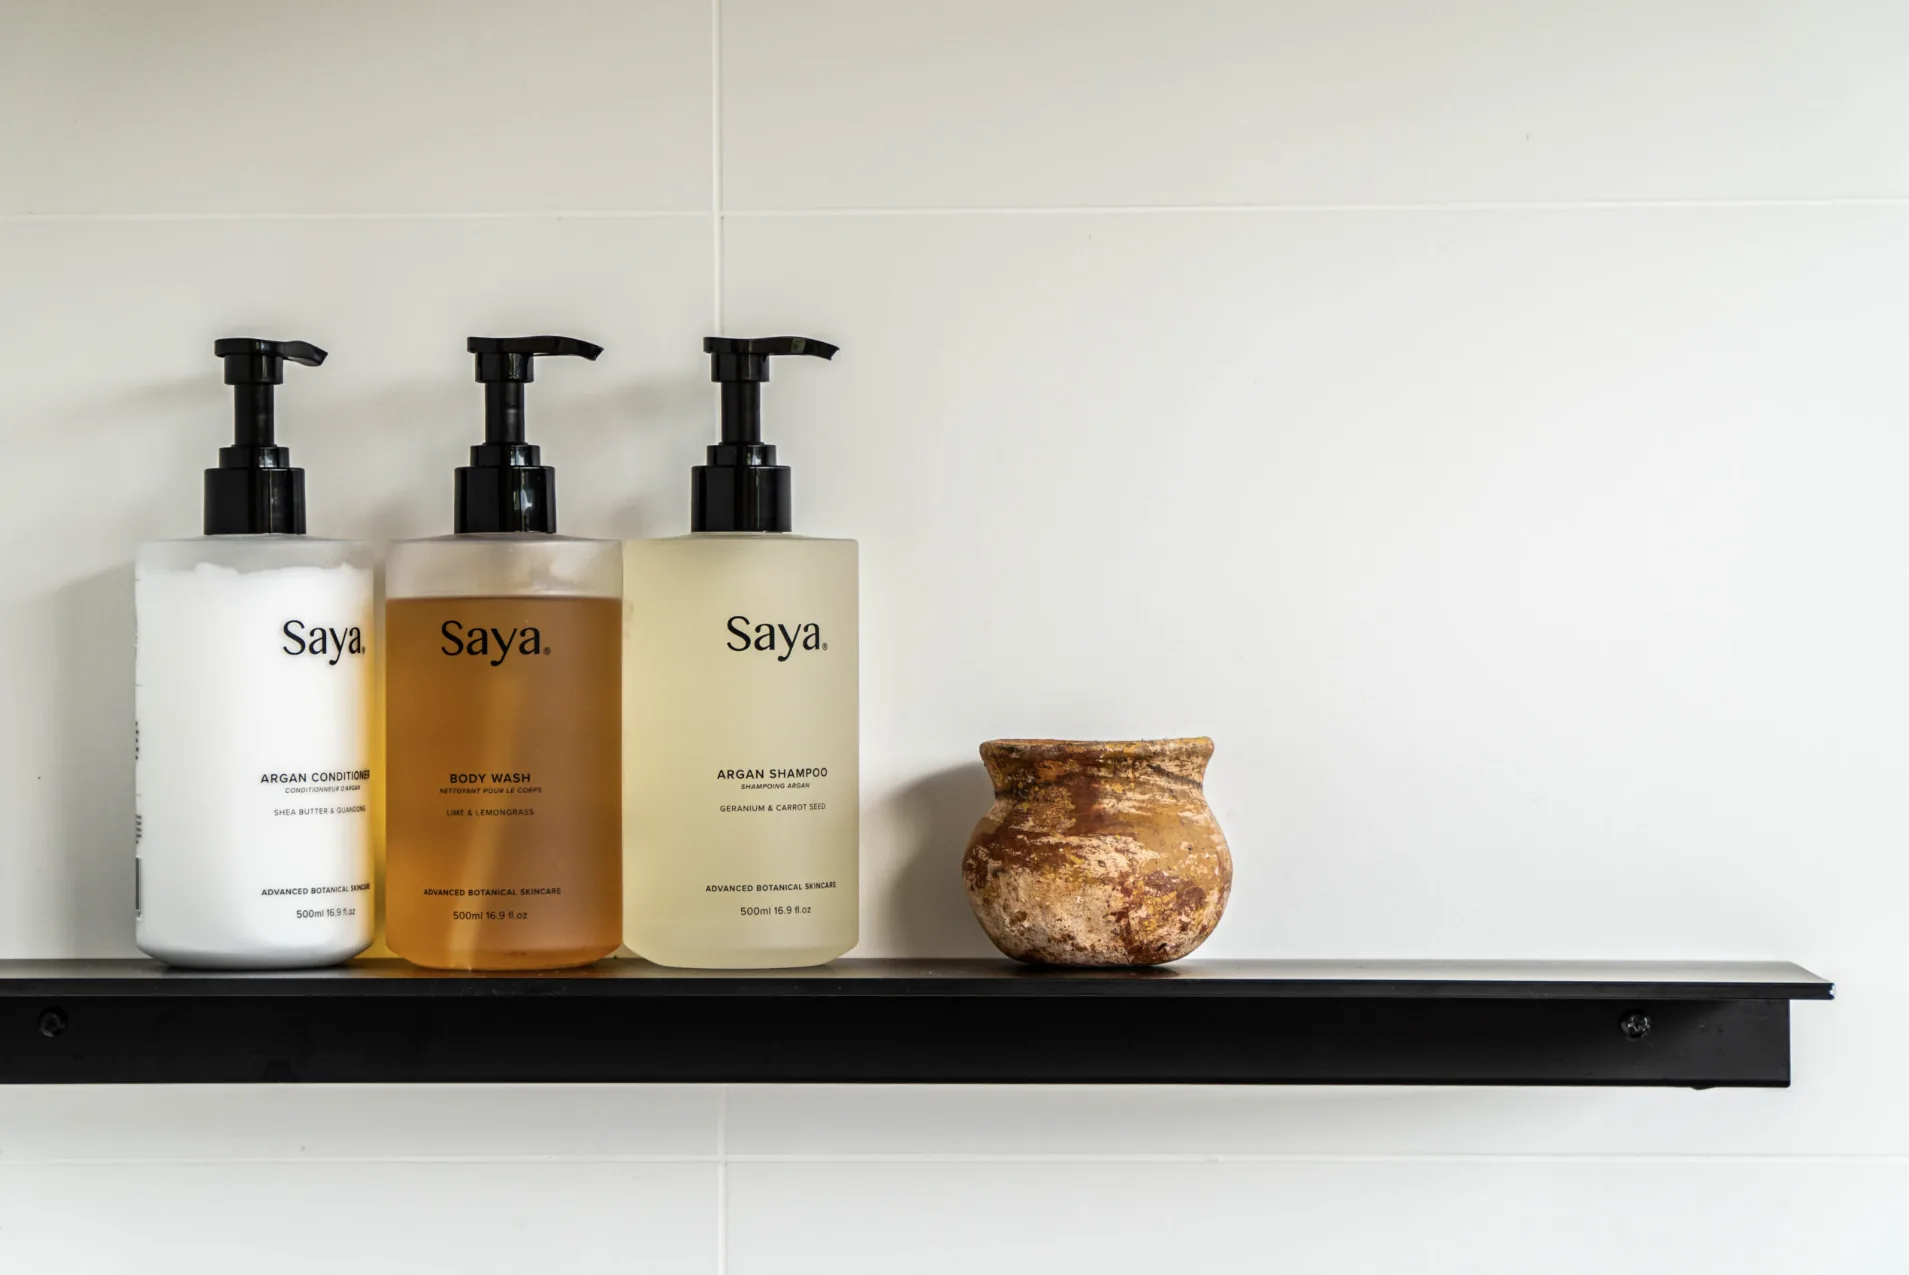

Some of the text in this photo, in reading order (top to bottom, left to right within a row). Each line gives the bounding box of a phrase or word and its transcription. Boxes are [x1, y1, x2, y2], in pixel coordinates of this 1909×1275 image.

[260, 769, 371, 784] ARGAN CONDITIONER
[450, 773, 531, 784] BODY WASH
[717, 767, 828, 780] ARGAN SHAMPOO
[299, 807, 328, 816] BUTTER
[446, 808, 535, 817] LIME & LEMONGRASS
[720, 805, 766, 813] GERANIUM
[776, 803, 808, 812] CARROT
[809, 802, 826, 811] SEED
[261, 888, 309, 896] ADVANCED
[311, 886, 349, 895] BOTANICAL
[520, 887, 562, 896] SKINCARE
[705, 881, 837, 893] ADVANCED BOTANICAL SKINCARE
[296, 909, 325, 919] 500ml
[326, 908, 342, 917] 16.9
[453, 911, 483, 920] 500ml
[486, 911, 506, 920] 16.9
[740, 907, 772, 916] 500ml
[774, 906, 793, 915] 16.9
